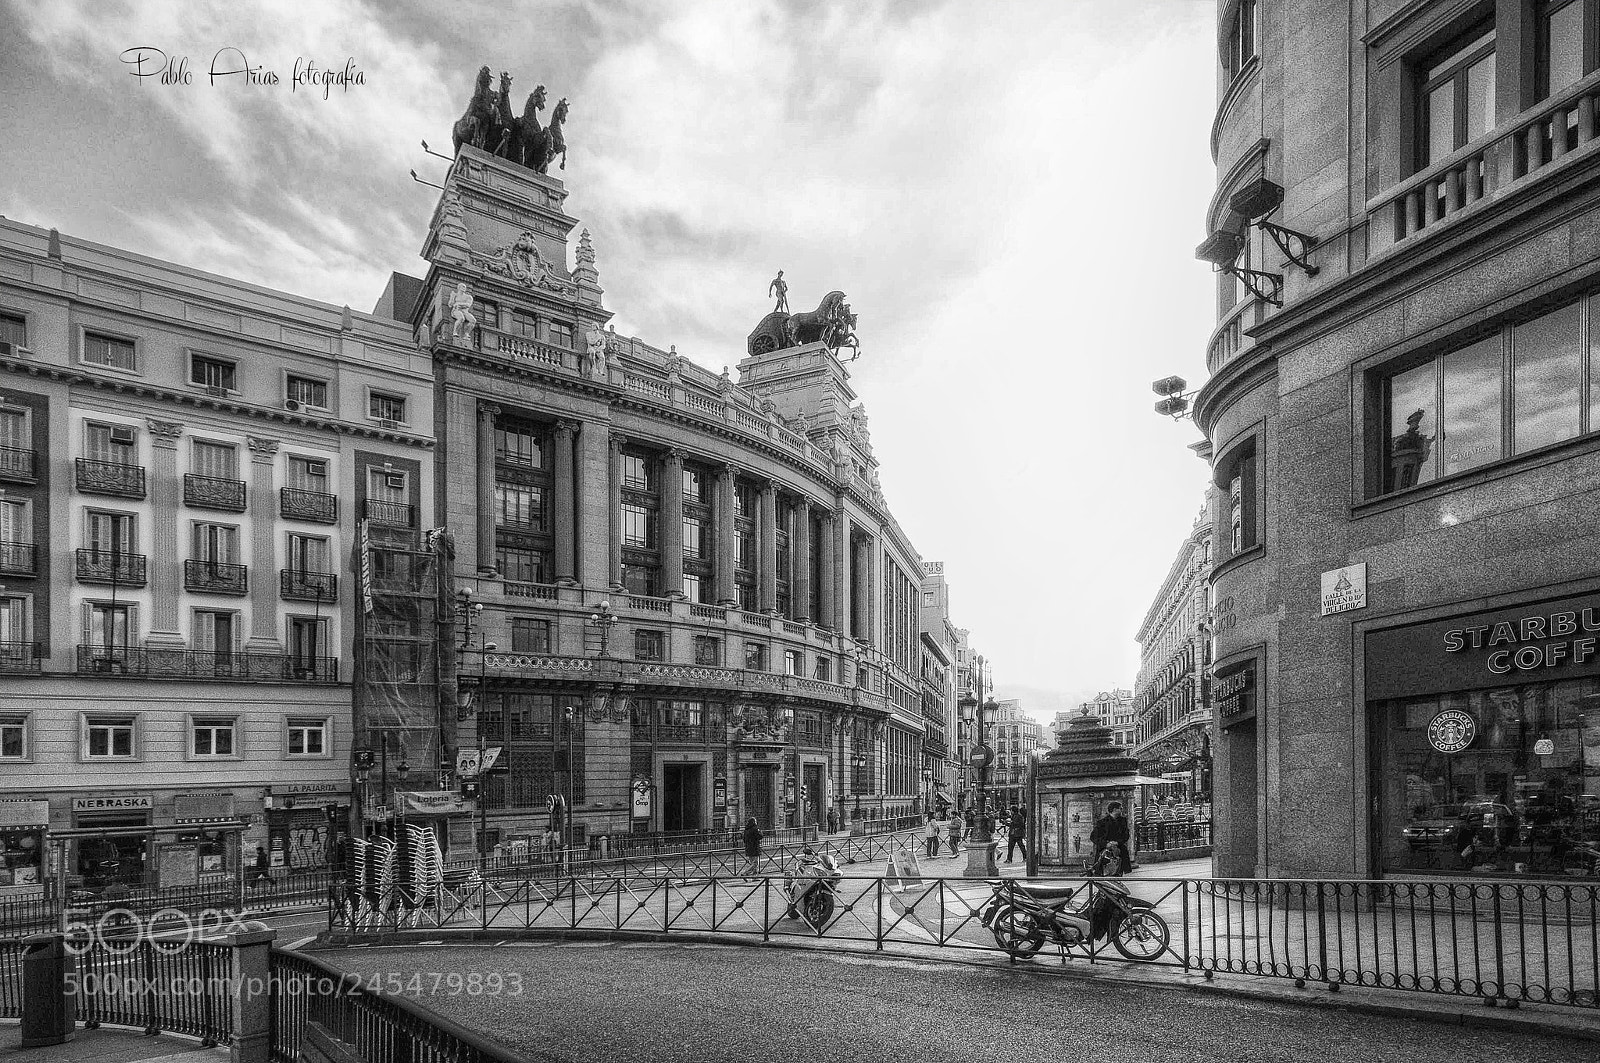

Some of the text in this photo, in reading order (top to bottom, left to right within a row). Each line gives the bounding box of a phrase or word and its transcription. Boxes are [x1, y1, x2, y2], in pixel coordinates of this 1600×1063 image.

[1430, 712, 1473, 731] STARBUCKS
[1434, 739, 1467, 751] COFFEE
[301, 784, 337, 793] PAJARITA
[77, 797, 148, 808] NEBRASKA
